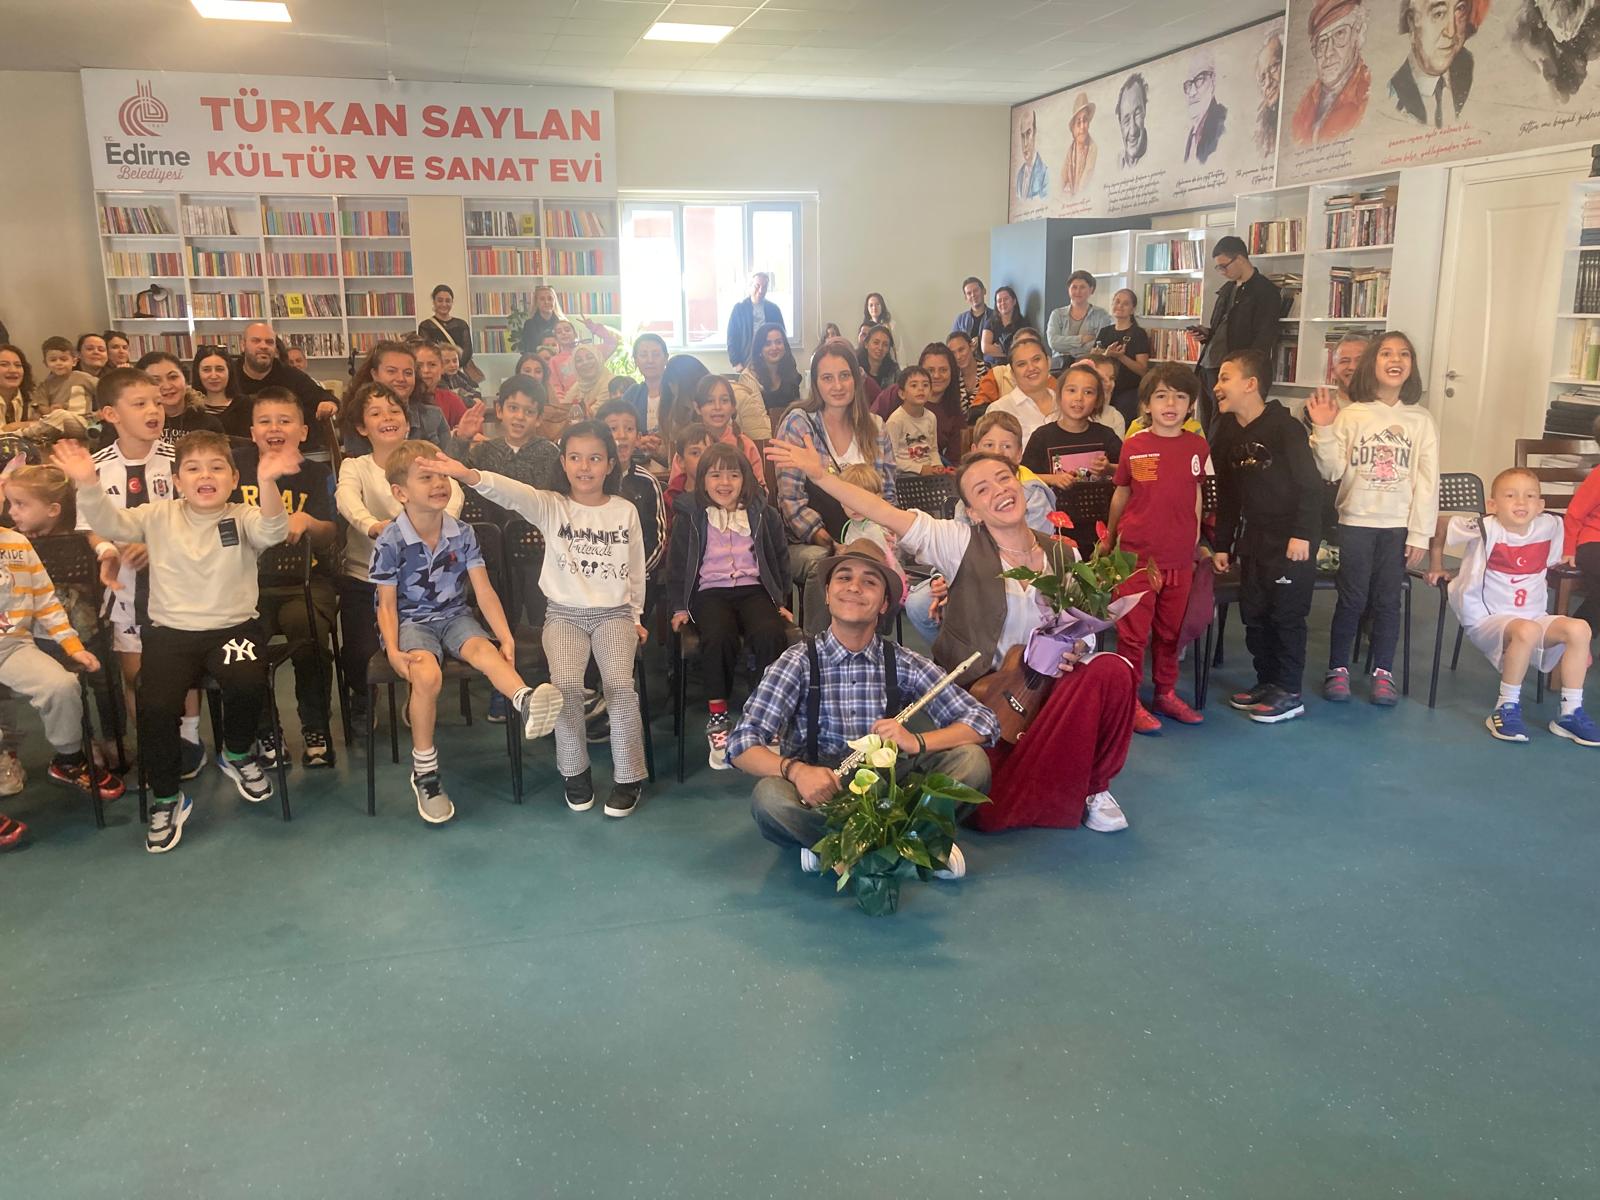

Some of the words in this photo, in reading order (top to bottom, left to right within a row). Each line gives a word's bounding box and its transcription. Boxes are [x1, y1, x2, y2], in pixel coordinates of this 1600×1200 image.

[200, 88, 408, 137] TÜRKAN
[421, 104, 600, 141] SAYLAN
[105, 143, 191, 166] Edirne
[207, 144, 357, 179] KÜLTÜR
[367, 156, 415, 180] VE
[425, 156, 539, 182] SANAT
[550, 152, 602, 183] EVİ
[117, 165, 184, 184] Belediyesi
[241, 485, 308, 514] RAL
[1514, 588, 1527, 607] 8
